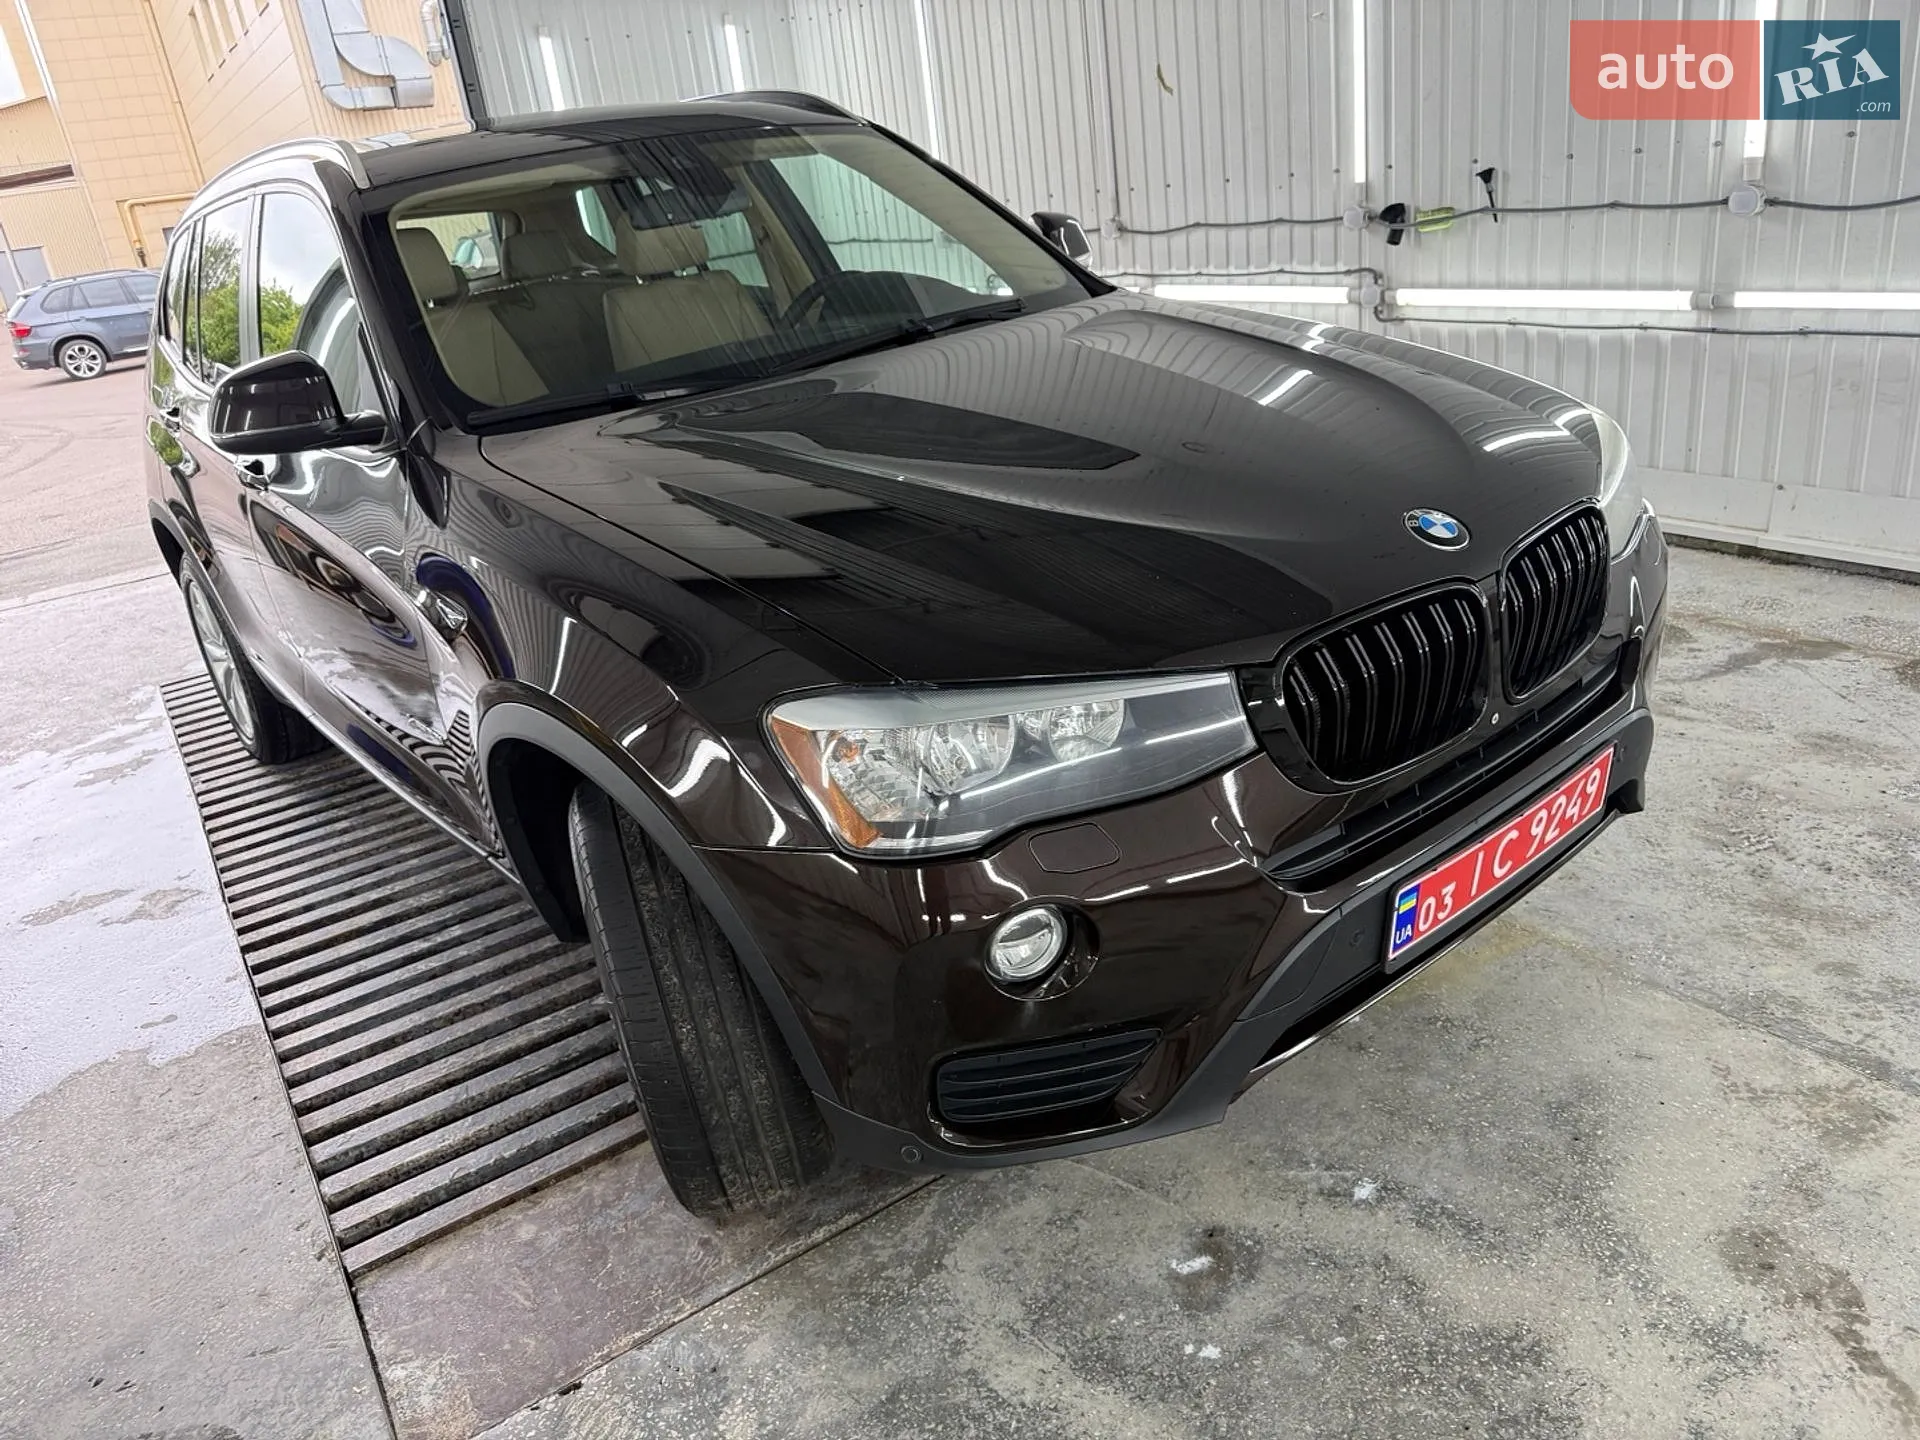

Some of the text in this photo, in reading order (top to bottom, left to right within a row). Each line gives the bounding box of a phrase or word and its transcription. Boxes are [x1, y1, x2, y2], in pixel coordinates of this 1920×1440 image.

[1419, 882, 1456, 931] 03
[1526, 768, 1601, 858] 9249
[1395, 924, 1412, 944] UA
